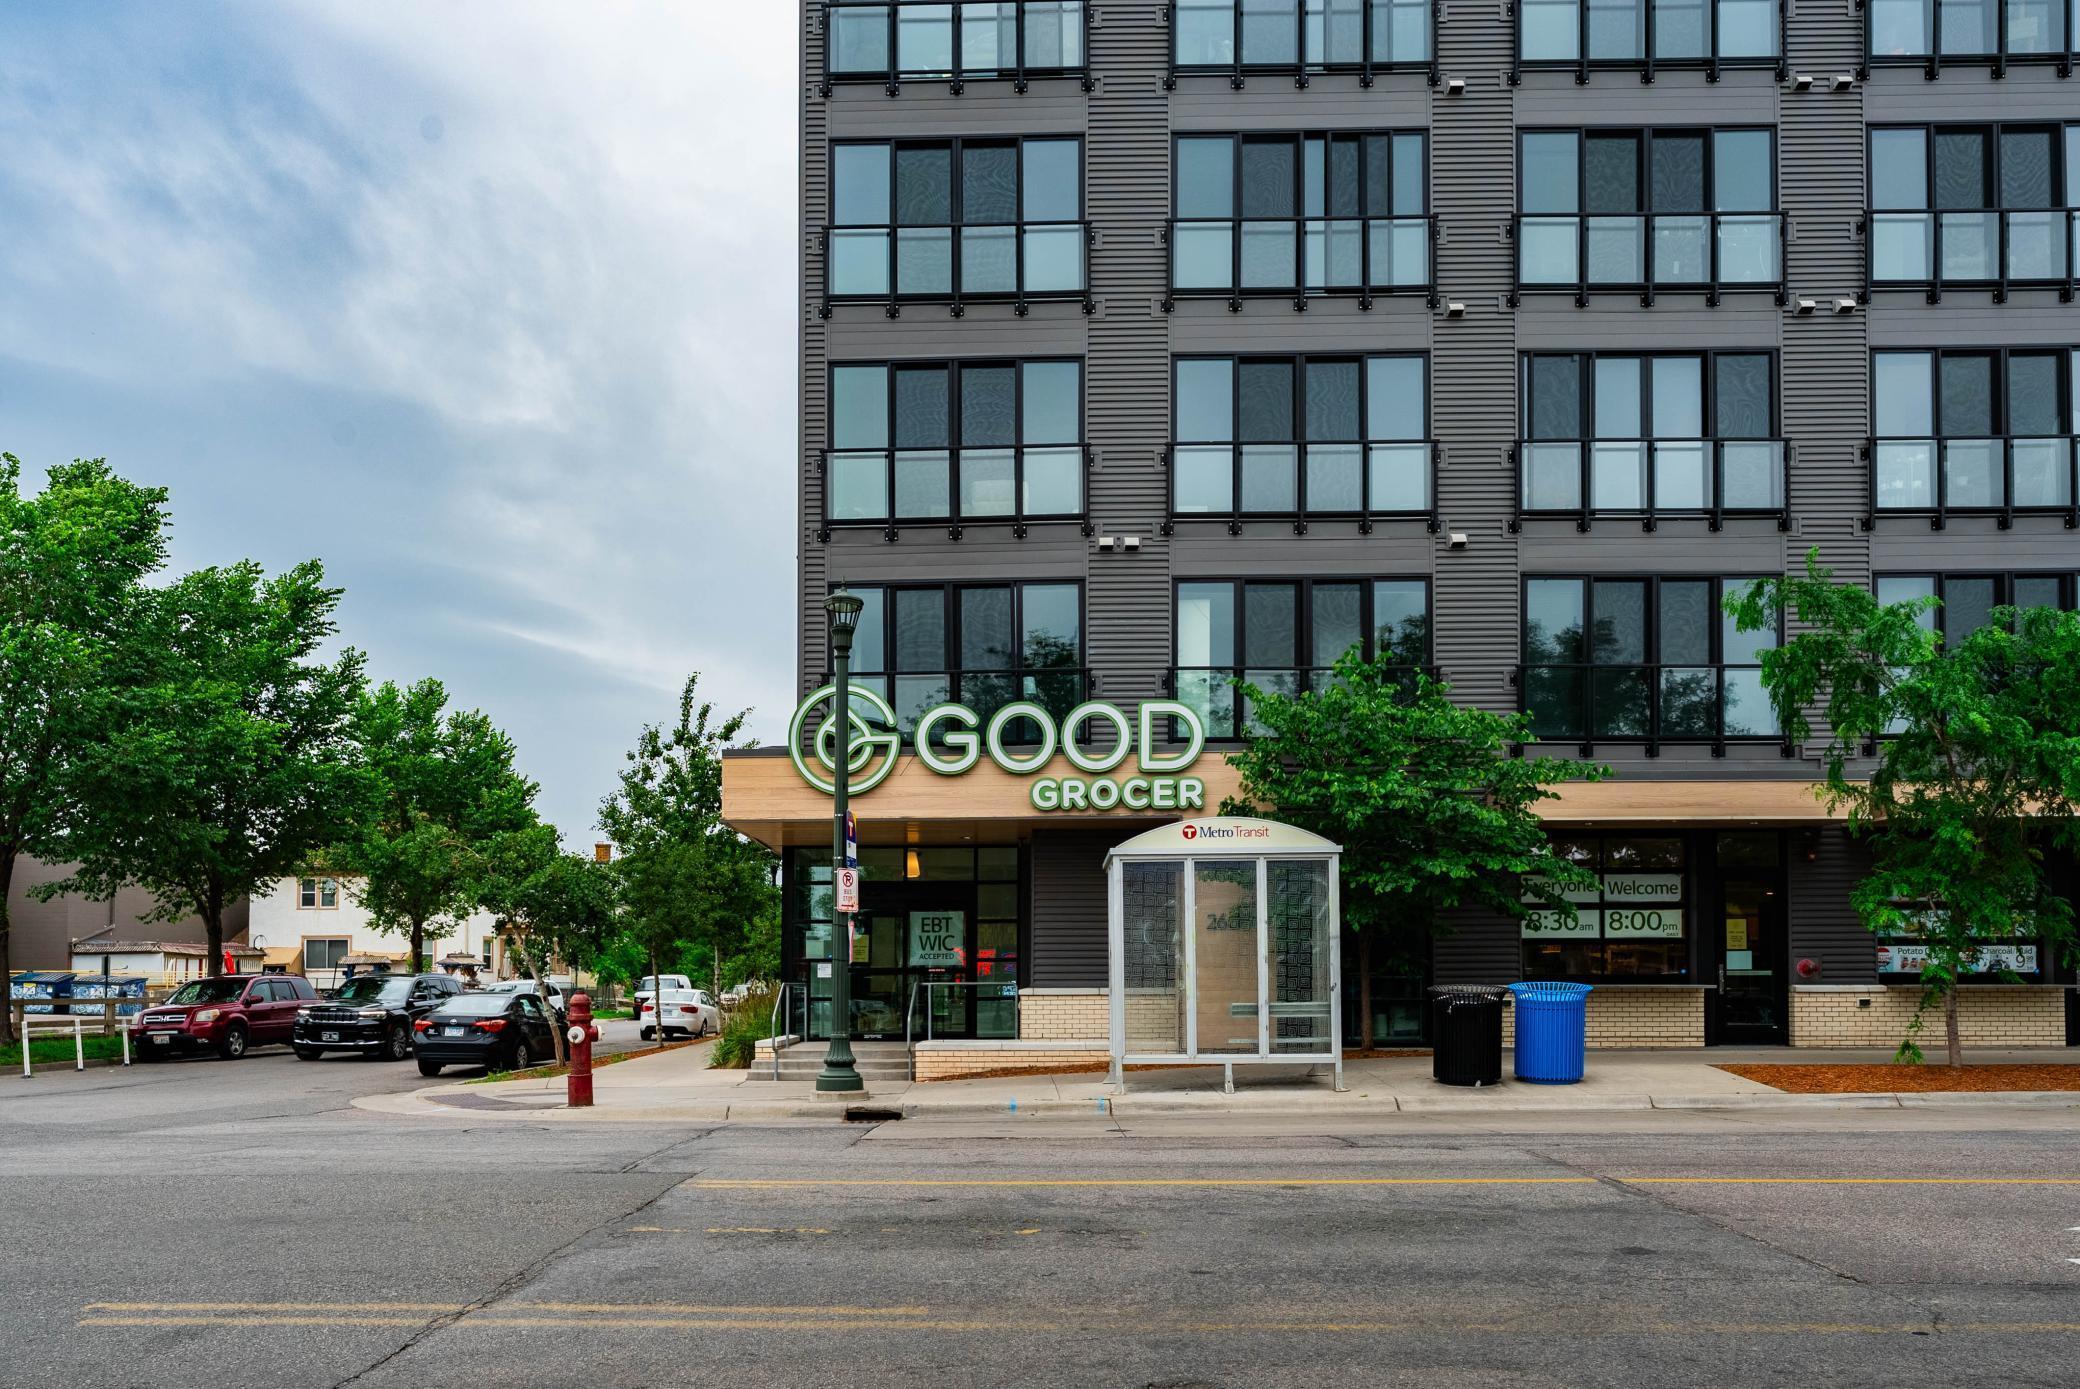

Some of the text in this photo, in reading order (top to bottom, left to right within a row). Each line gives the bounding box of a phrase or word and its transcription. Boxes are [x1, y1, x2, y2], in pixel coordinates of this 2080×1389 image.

[914, 700, 1206, 775] GOOD
[1030, 776, 1206, 811] GROCER
[1608, 881, 1679, 895] Welcome
[921, 917, 953, 933] EBT
[919, 935, 956, 951] WIC
[1897, 947, 1924, 955] Potato
